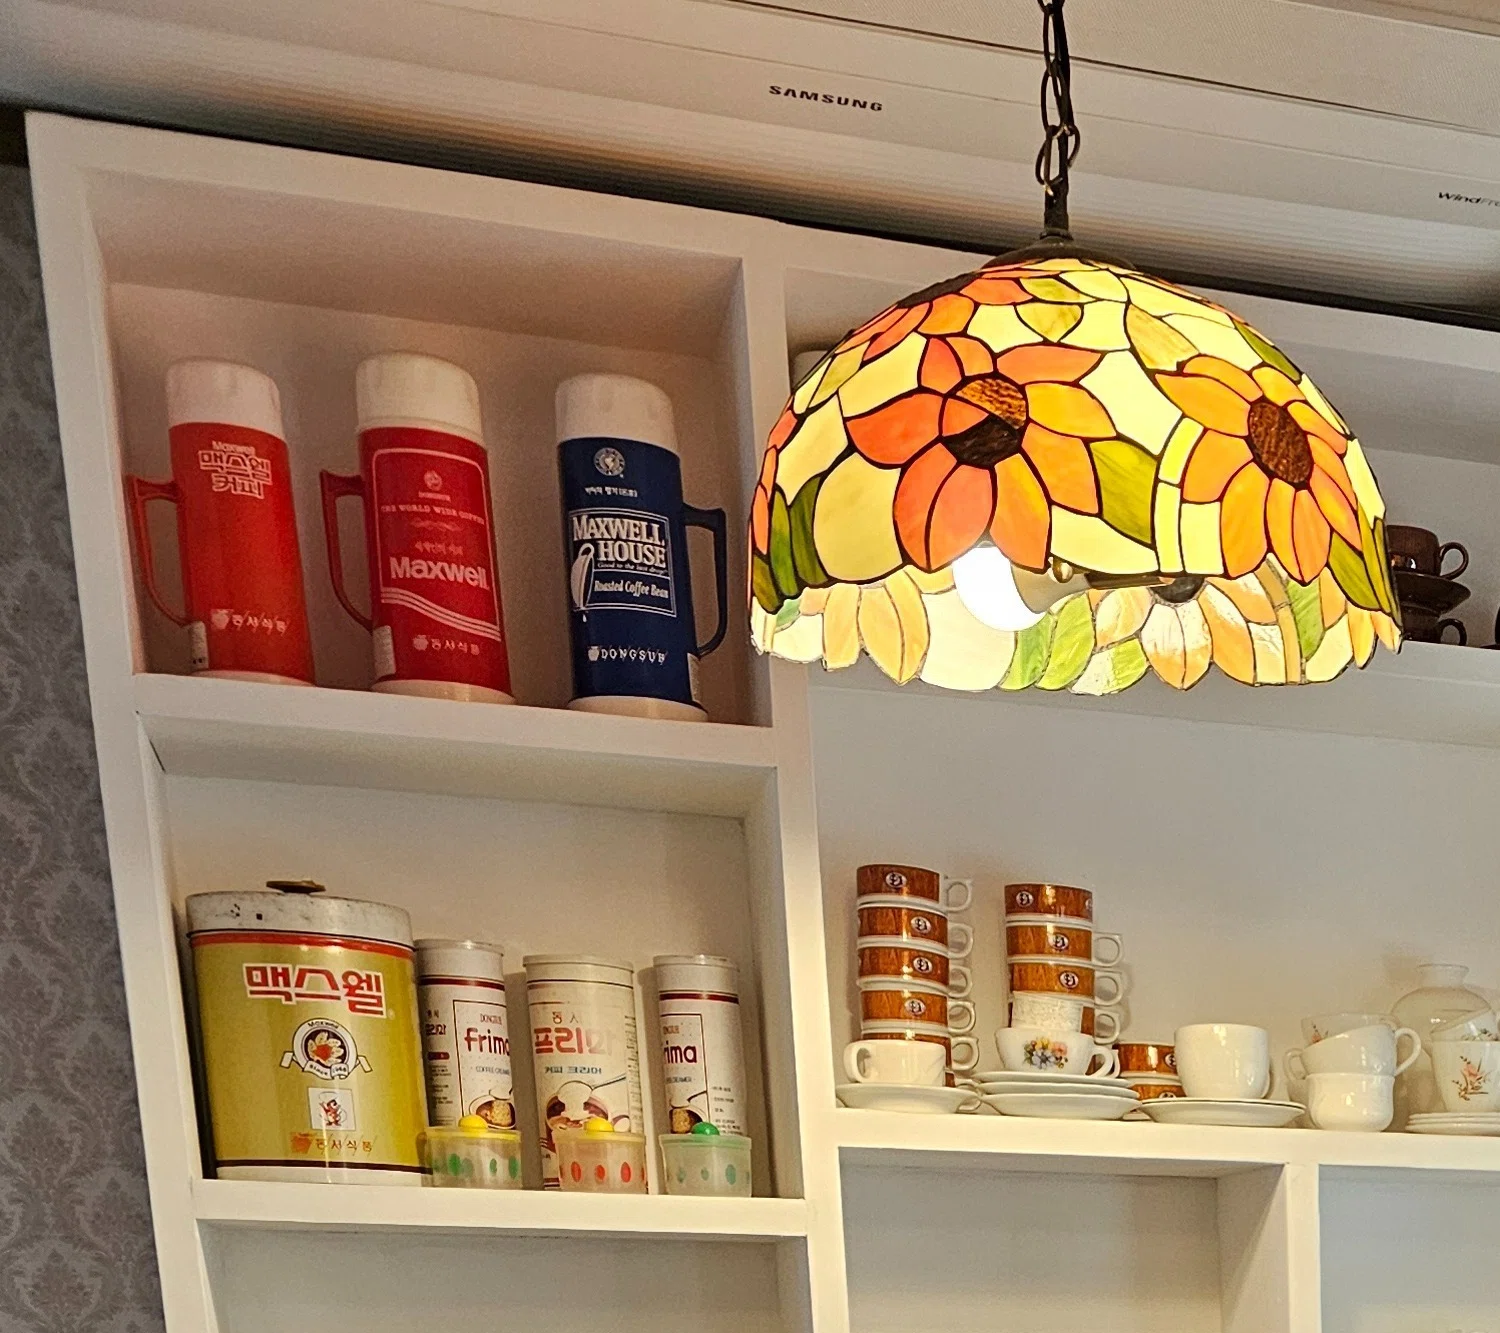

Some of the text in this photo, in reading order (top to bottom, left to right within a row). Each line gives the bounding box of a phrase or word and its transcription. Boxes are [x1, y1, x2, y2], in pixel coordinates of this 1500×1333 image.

[769, 85, 883, 111] SAMSUNG
[198, 450, 273, 487] 맥스웰
[211, 472, 264, 499] 커피
[572, 515, 661, 546] MAXWELL
[597, 540, 667, 568] HOUSE
[390, 557, 489, 590] Maxwell
[594, 580, 669, 599] Roasted Coffee Bean
[601, 647, 667, 664] DONGSUH
[244, 964, 386, 1018] 맥스웰
[534, 1026, 616, 1056] 프리마
